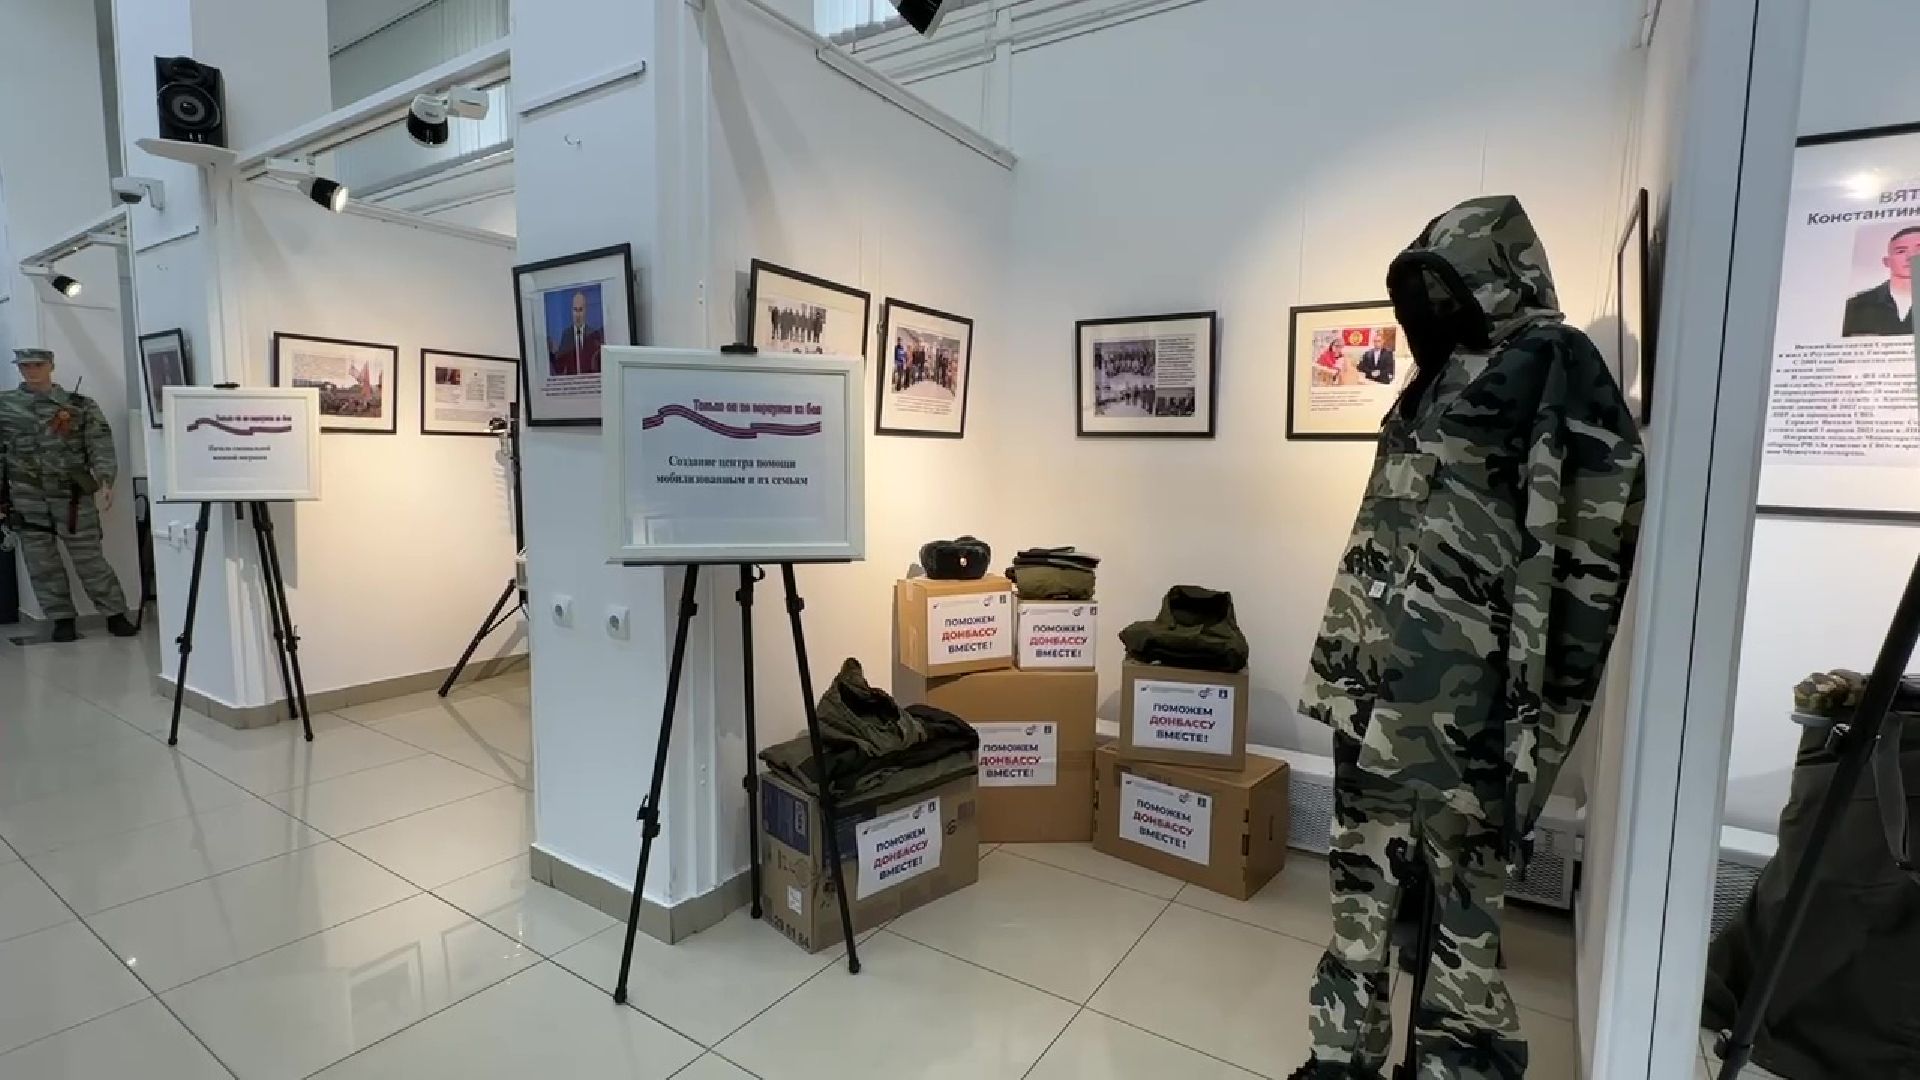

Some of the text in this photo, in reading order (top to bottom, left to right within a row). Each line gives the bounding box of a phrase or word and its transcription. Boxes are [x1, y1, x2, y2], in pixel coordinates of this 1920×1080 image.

[1807, 207, 1920, 225] Константин
[668, 455, 796, 470] Создание центра помощи
[656, 471, 808, 485] мобилизованным и их семьям
[945, 615, 995, 627] ПОМОЖЕМ
[1033, 624, 1084, 632] ПОМОЖЕМ
[942, 628, 997, 642] ДОНБАССУ
[1030, 636, 1088, 646] ДОНБАССУ
[948, 641, 993, 654] ВМЕСТЕ!
[1036, 648, 1082, 657] ВМЕСТЕ!
[1153, 703, 1213, 715] ПОМОЖЕМ
[1149, 716, 1216, 729] ДОНБАССУ
[1156, 730, 1208, 742] ВМЕСТЕ!
[984, 744, 1038, 752] ПОМОЖЕМ
[980, 756, 1041, 766] ДОНБАССУ
[986, 768, 1033, 777] ВМЕСТЕ!
[1137, 799, 1191, 822] ПОМОЖЕМ
[1133, 811, 1194, 836] ДОНБАССУ
[877, 827, 925, 852] ПОМОЖЕМ
[1140, 826, 1186, 849] ВМЕСТЕ!
[874, 840, 928, 869] ДОНБАССУ
[880, 856, 922, 880] ВМЕСТЕ!
